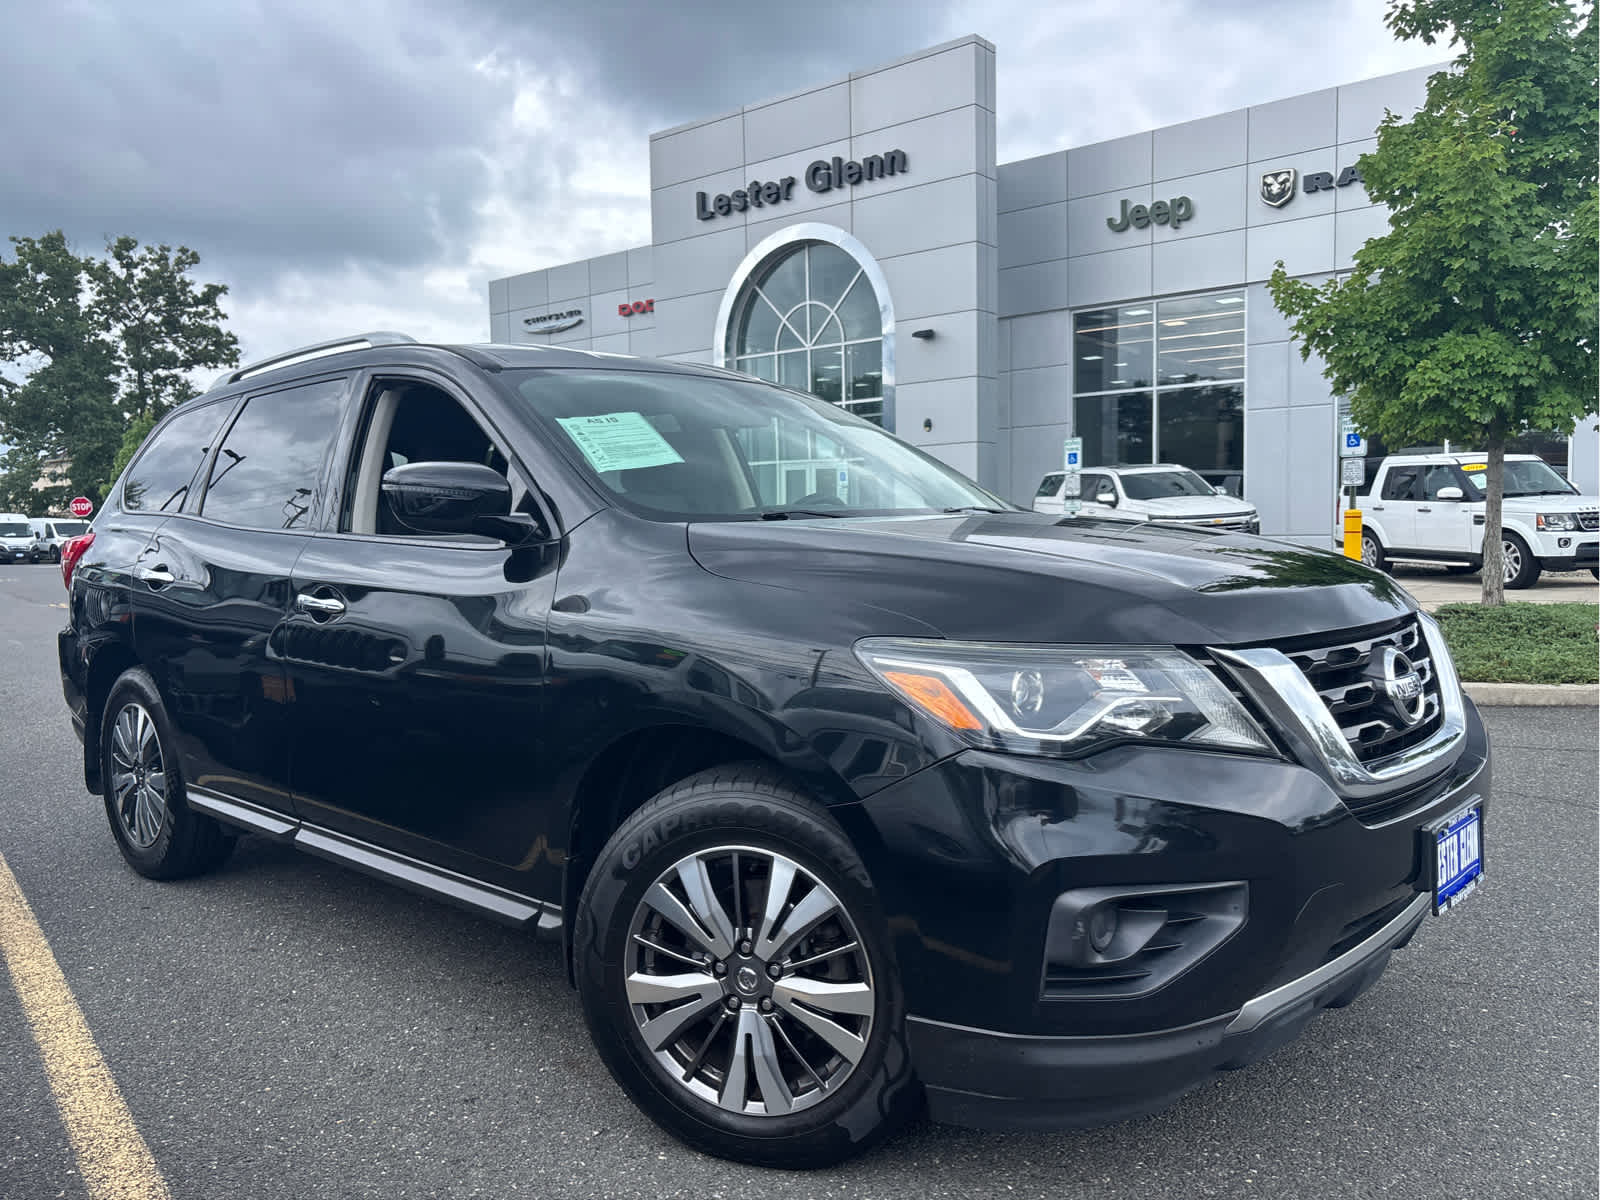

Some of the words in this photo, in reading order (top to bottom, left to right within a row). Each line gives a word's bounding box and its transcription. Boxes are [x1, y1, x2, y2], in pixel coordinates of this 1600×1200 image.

[696, 176, 796, 221] Lester
[805, 148, 909, 193] Glenn
[1303, 166, 1364, 194] RA
[1106, 195, 1195, 233] Jeep
[618, 299, 655, 317] DOD
[72, 502, 91, 511] STOP
[1437, 832, 1459, 888] ESTER
